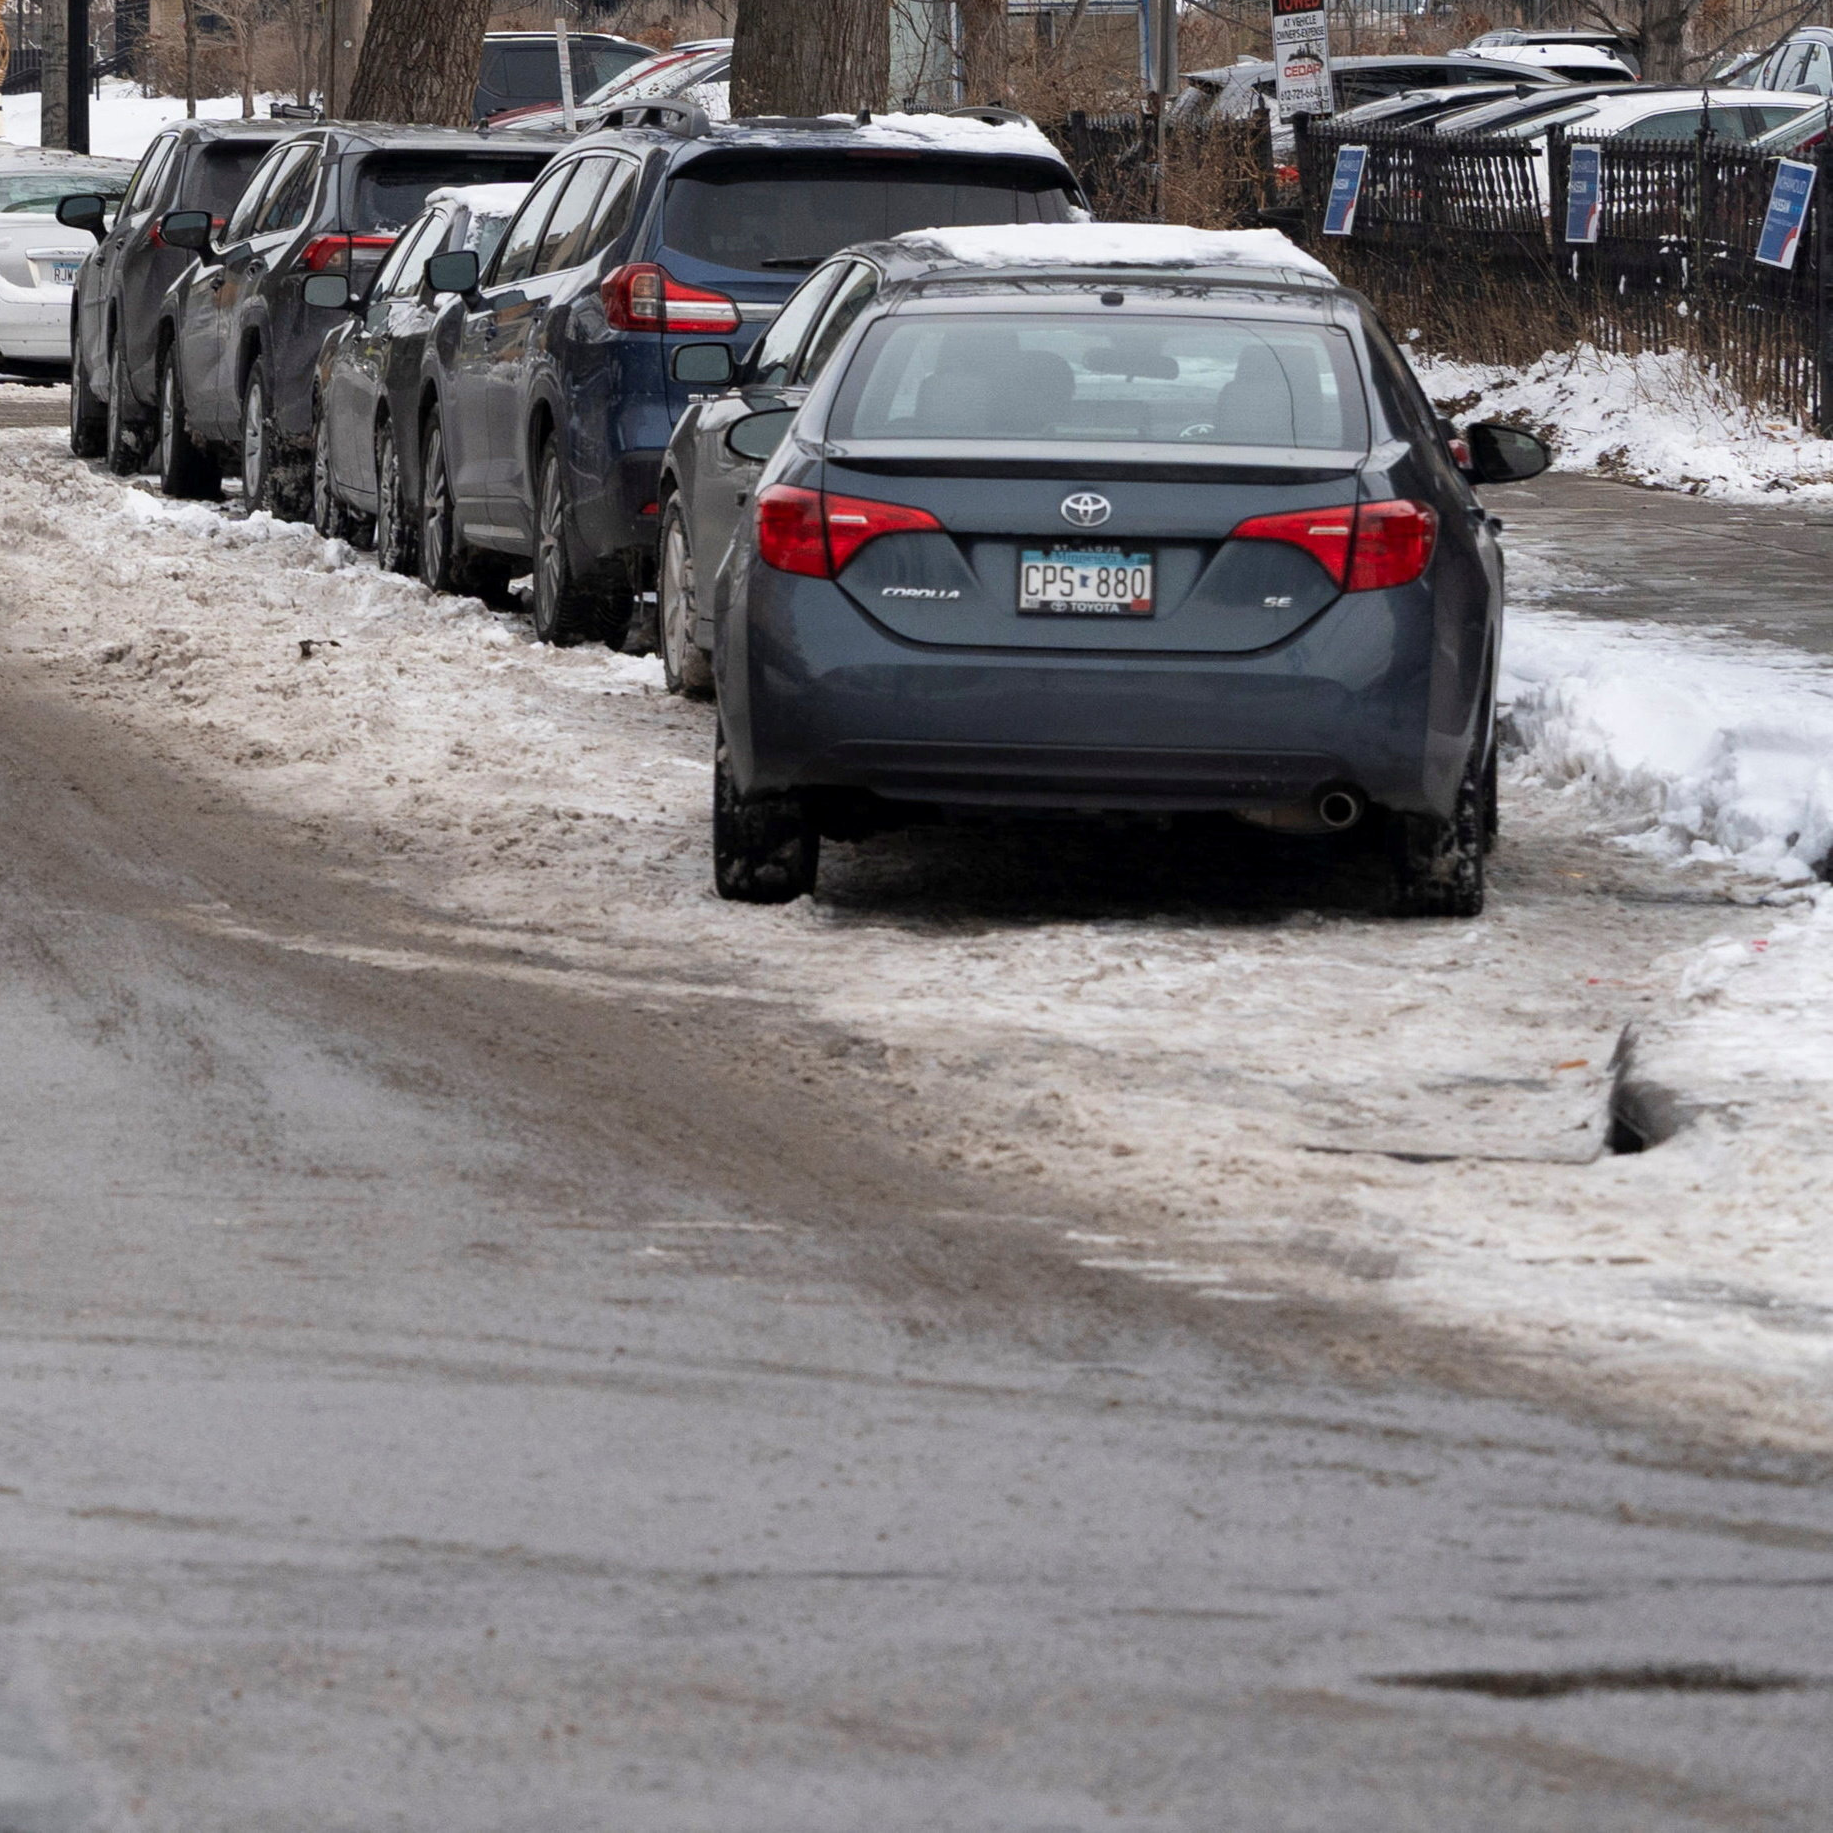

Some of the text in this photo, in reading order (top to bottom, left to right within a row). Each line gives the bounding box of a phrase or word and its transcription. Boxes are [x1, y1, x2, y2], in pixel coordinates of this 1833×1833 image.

[1283, 14, 1317, 27] AT VEHICLE
[1284, 63, 1322, 78] CEDAR
[1025, 565, 1145, 599] CPS 880
[881, 587, 961, 599] COROLLA
[1070, 603, 1120, 613] TOYOTA
[1264, 596, 1293, 608] SE
